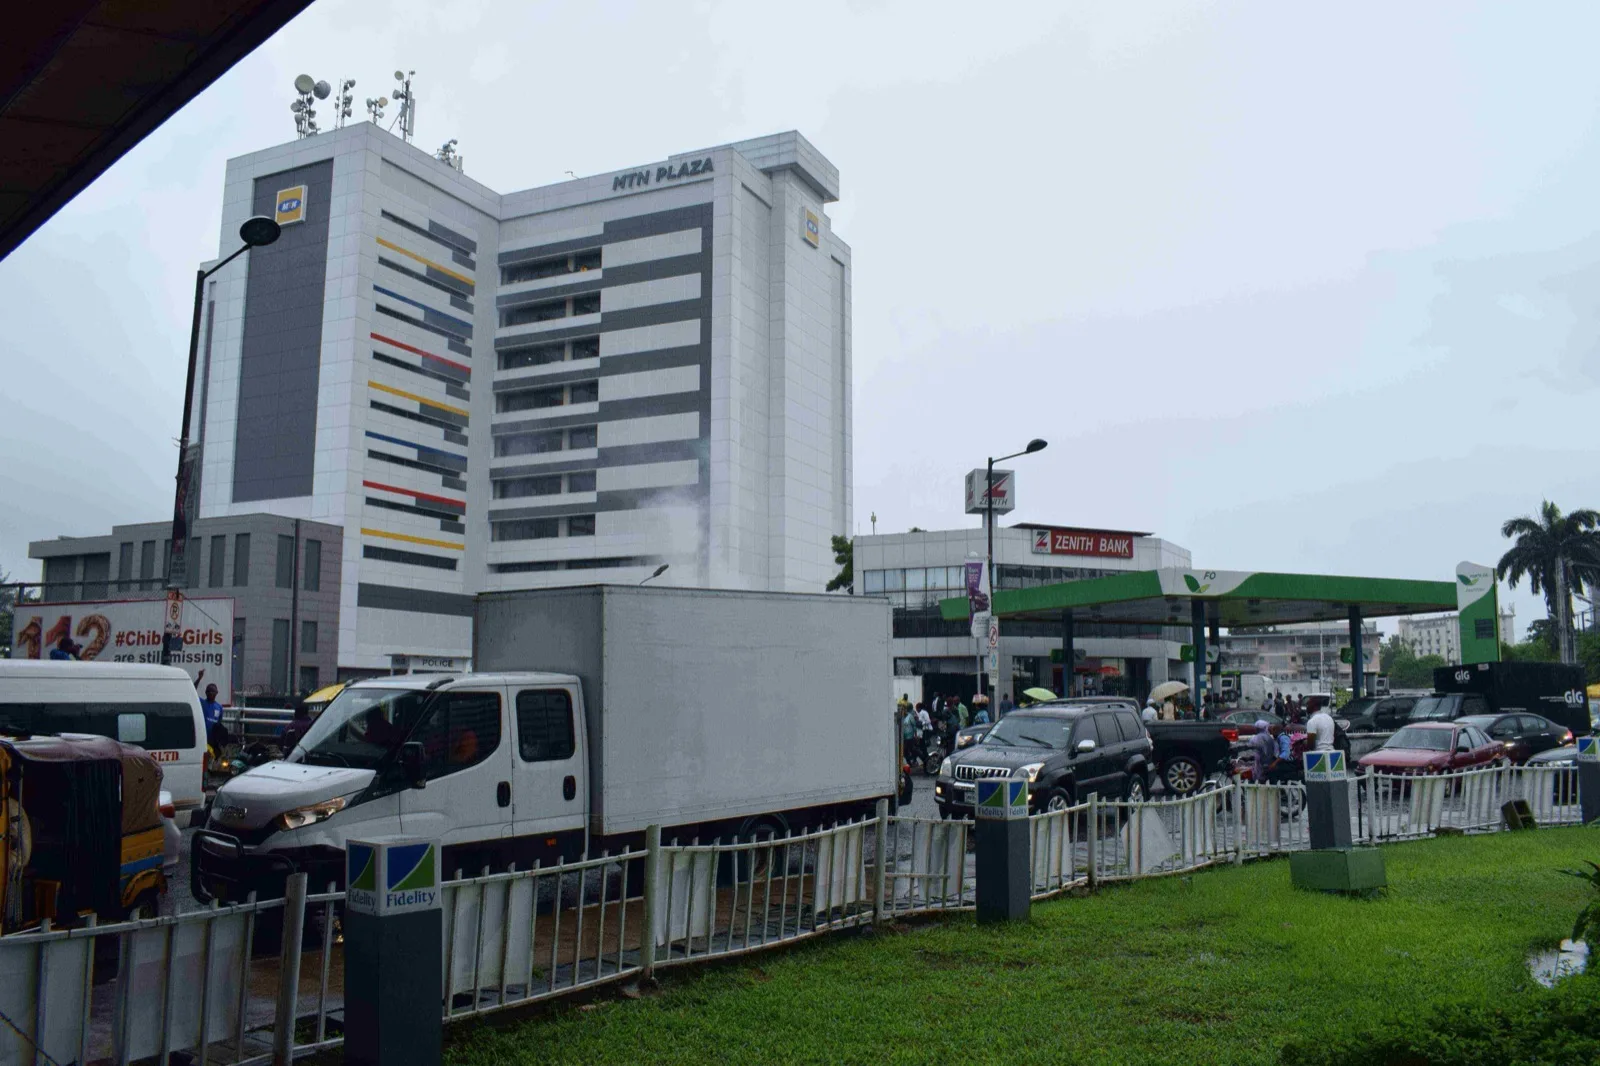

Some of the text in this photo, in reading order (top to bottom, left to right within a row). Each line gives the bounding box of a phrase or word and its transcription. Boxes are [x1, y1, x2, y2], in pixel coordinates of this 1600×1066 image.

[613, 157, 714, 191] MTN PLAZA
[1055, 535, 1129, 553] ZENITH BANK
[1203, 571, 1216, 580] FO
[115, 629, 223, 647] #ChibGirls
[114, 650, 223, 666] are still missing
[347, 888, 377, 912] Fidelity
[386, 891, 436, 908] Fidelity
